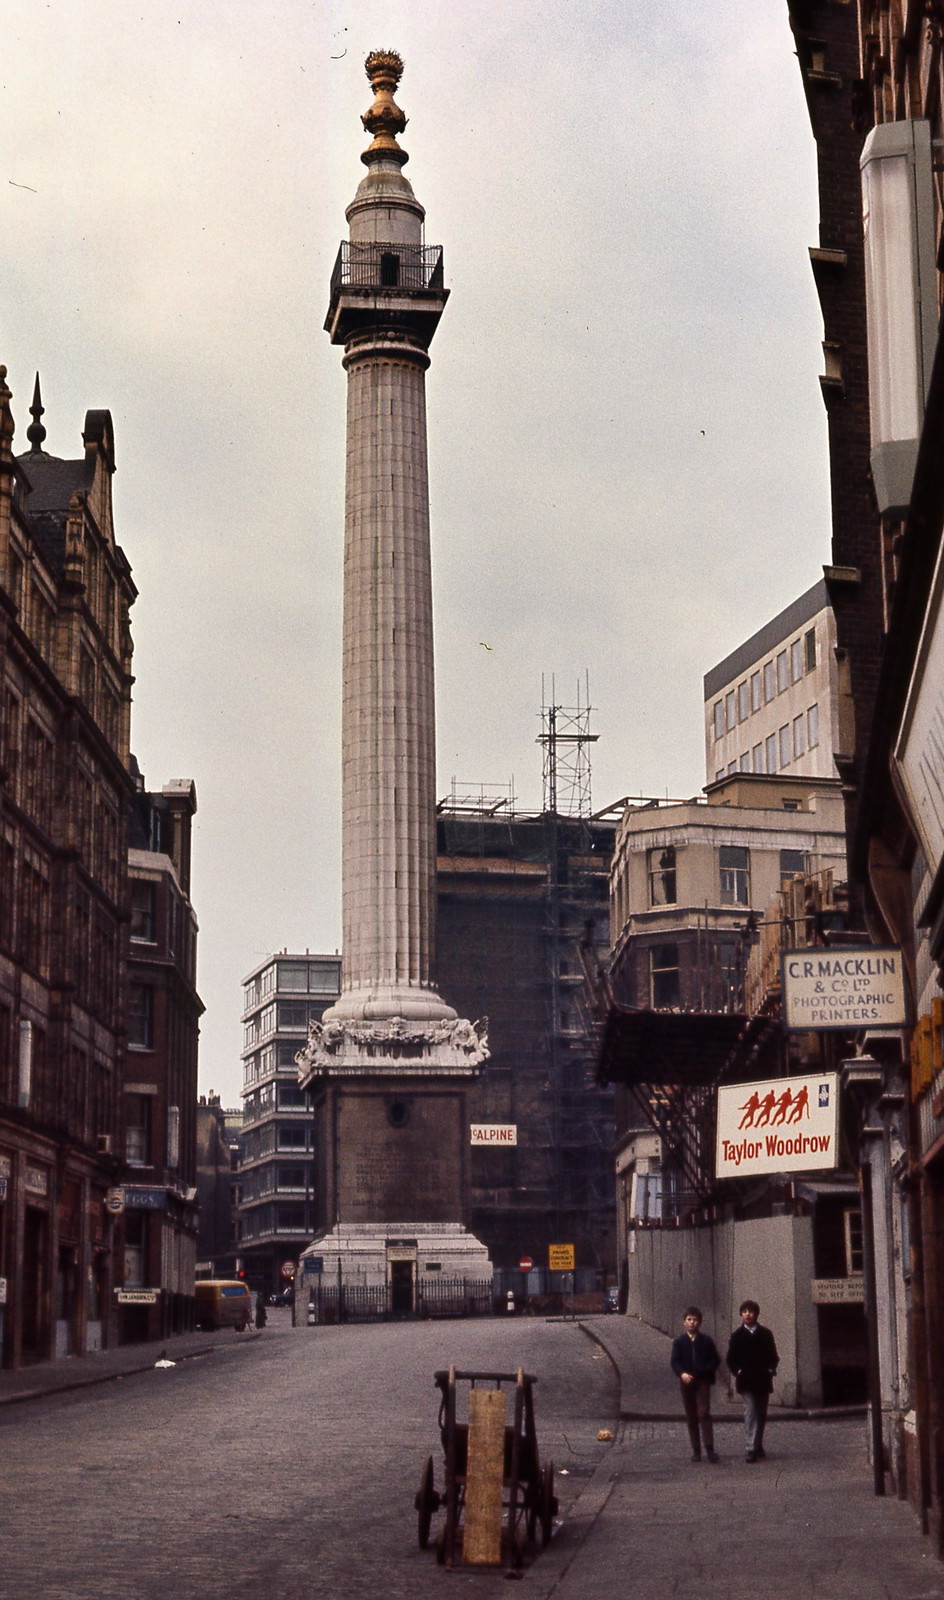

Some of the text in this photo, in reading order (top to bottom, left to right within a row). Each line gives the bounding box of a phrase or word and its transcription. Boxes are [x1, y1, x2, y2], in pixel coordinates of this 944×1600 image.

[814, 980, 825, 993] &
[793, 993, 895, 1008] PHOTOGRAPHIC
[722, 1132, 831, 1166] Taylor Woodrow
